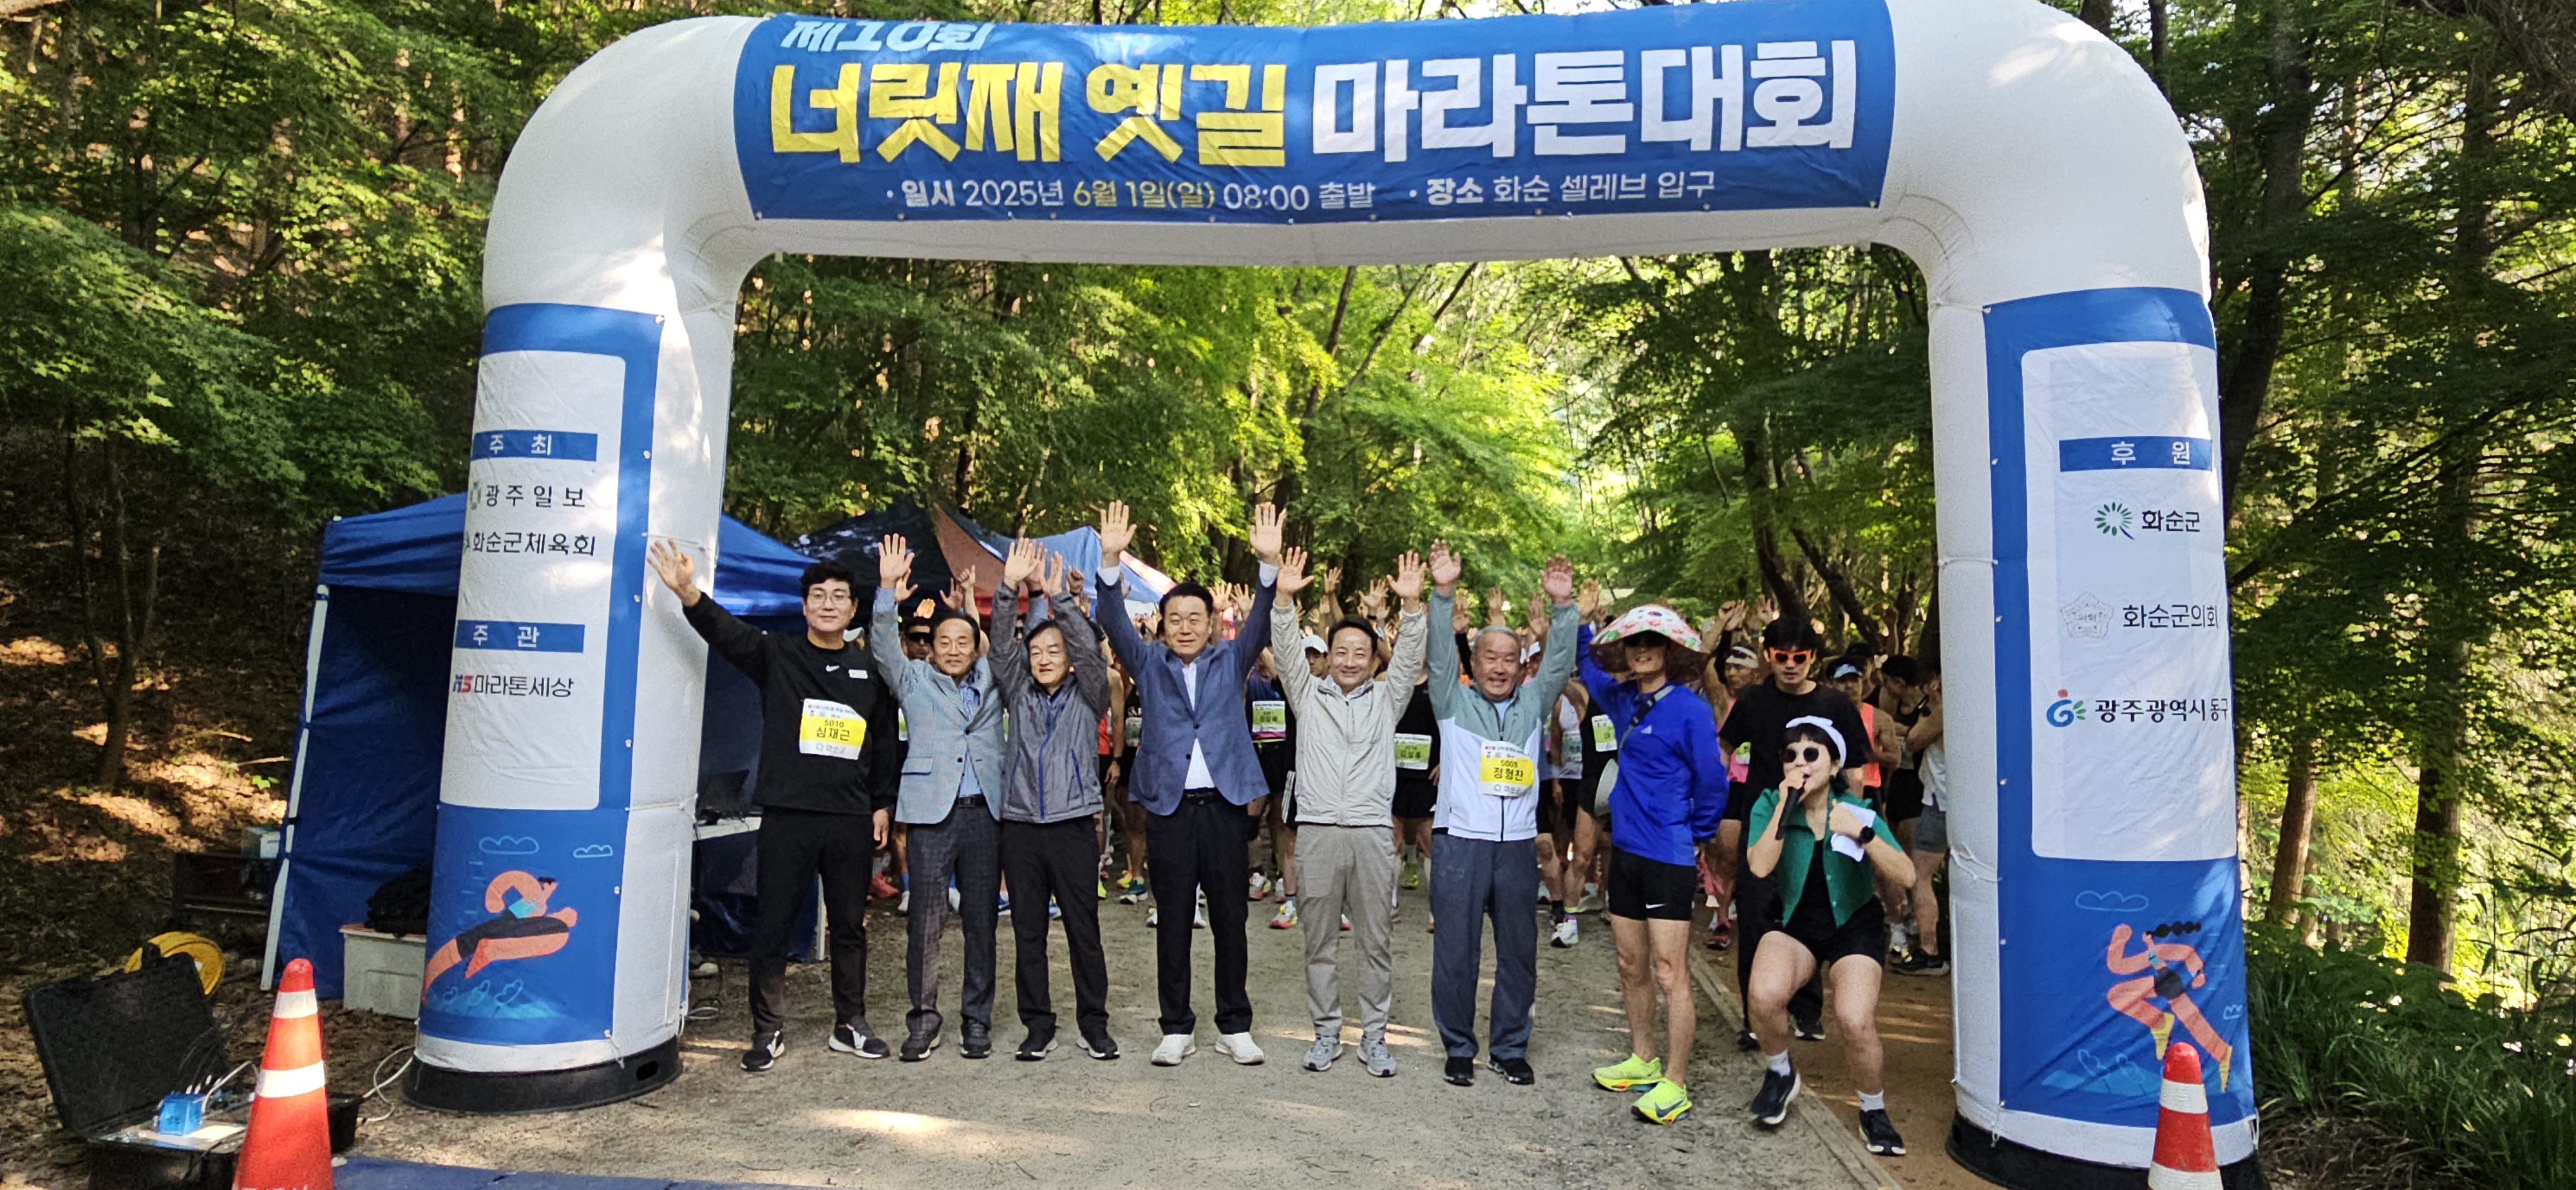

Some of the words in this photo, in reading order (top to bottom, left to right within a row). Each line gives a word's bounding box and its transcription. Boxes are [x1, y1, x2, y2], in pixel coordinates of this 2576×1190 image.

[781, 21, 996, 52] 제10회
[771, 62, 1063, 164] 너릿재
[1086, 62, 1287, 167] 옛길
[1312, 40, 1857, 162] 마라톤대회
[901, 180, 956, 207] 일시
[962, 180, 1064, 207] 2025년
[1073, 180, 1117, 207] 6월
[1125, 180, 1216, 209] 1일(일)
[1224, 184, 1310, 211] 08:00
[1318, 181, 1376, 209] 출발
[1427, 177, 1484, 205] 장소
[1493, 174, 1551, 203] 화순
[1560, 173, 1646, 203] 셀레브
[1658, 171, 1716, 199] 입구
[2141, 509, 2201, 533] 화순군
[472, 531, 596, 556] 화순군체육회
[2122, 604, 2219, 628] 화순군의회
[474, 674, 574, 698] 마라톤세상
[816, 726, 851, 742] 심재근
[824, 719, 844, 728] 5010
